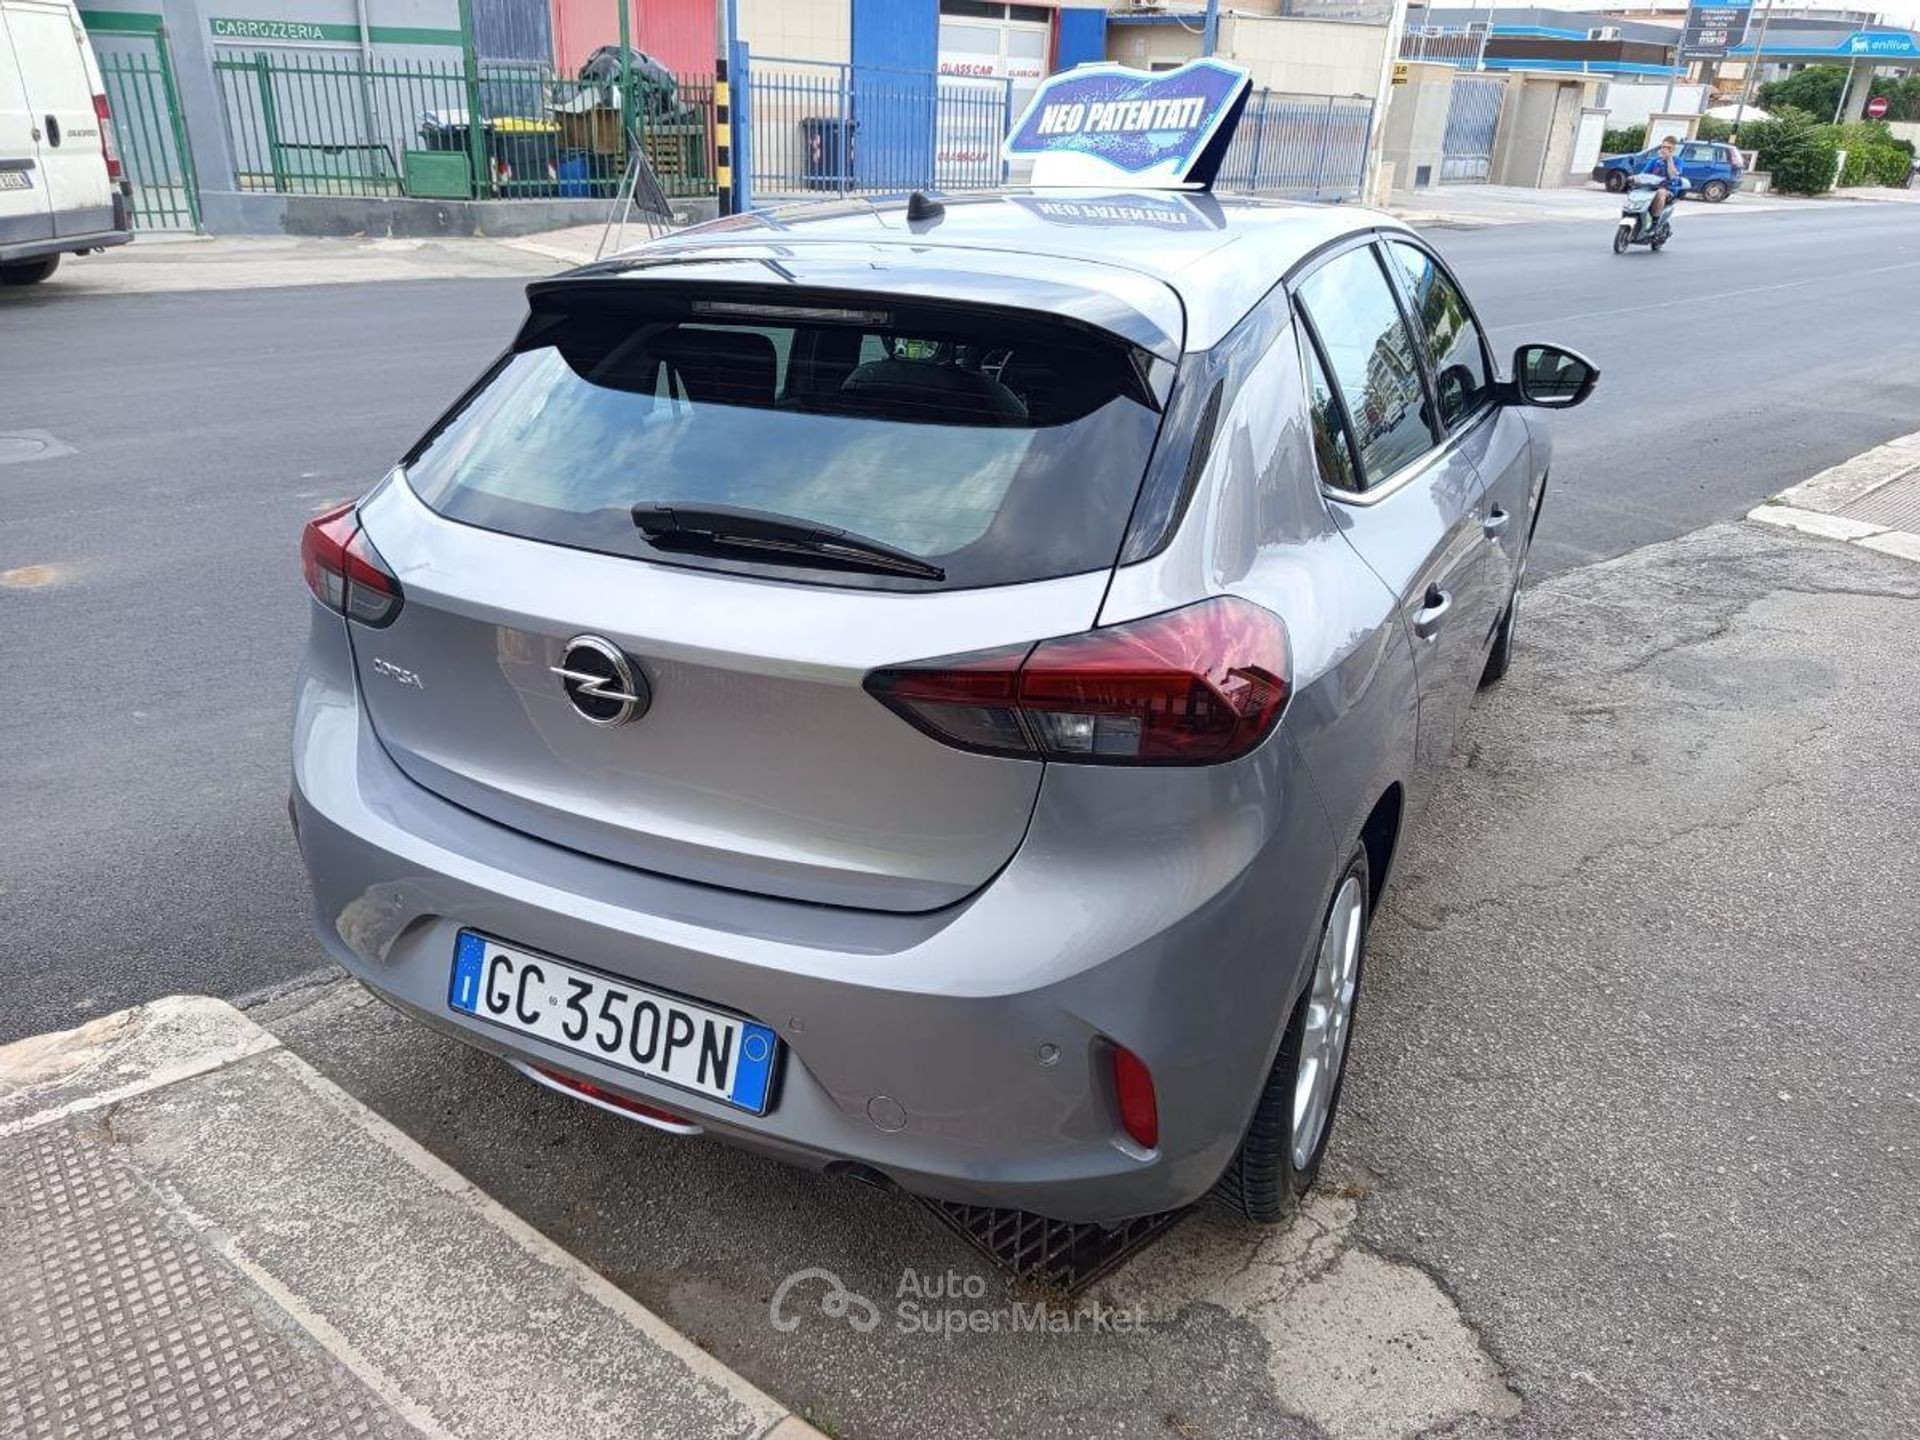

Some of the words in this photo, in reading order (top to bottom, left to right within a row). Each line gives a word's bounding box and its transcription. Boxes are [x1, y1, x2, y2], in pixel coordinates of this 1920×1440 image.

[215, 20, 325, 39] CARROZZERIA
[941, 63, 972, 75] GLASS
[973, 65, 993, 75] CAR
[1037, 103, 1086, 135] NEO
[1083, 97, 1206, 133] PATENTATI
[485, 955, 545, 1025] GC
[562, 977, 734, 1091] 350PN
